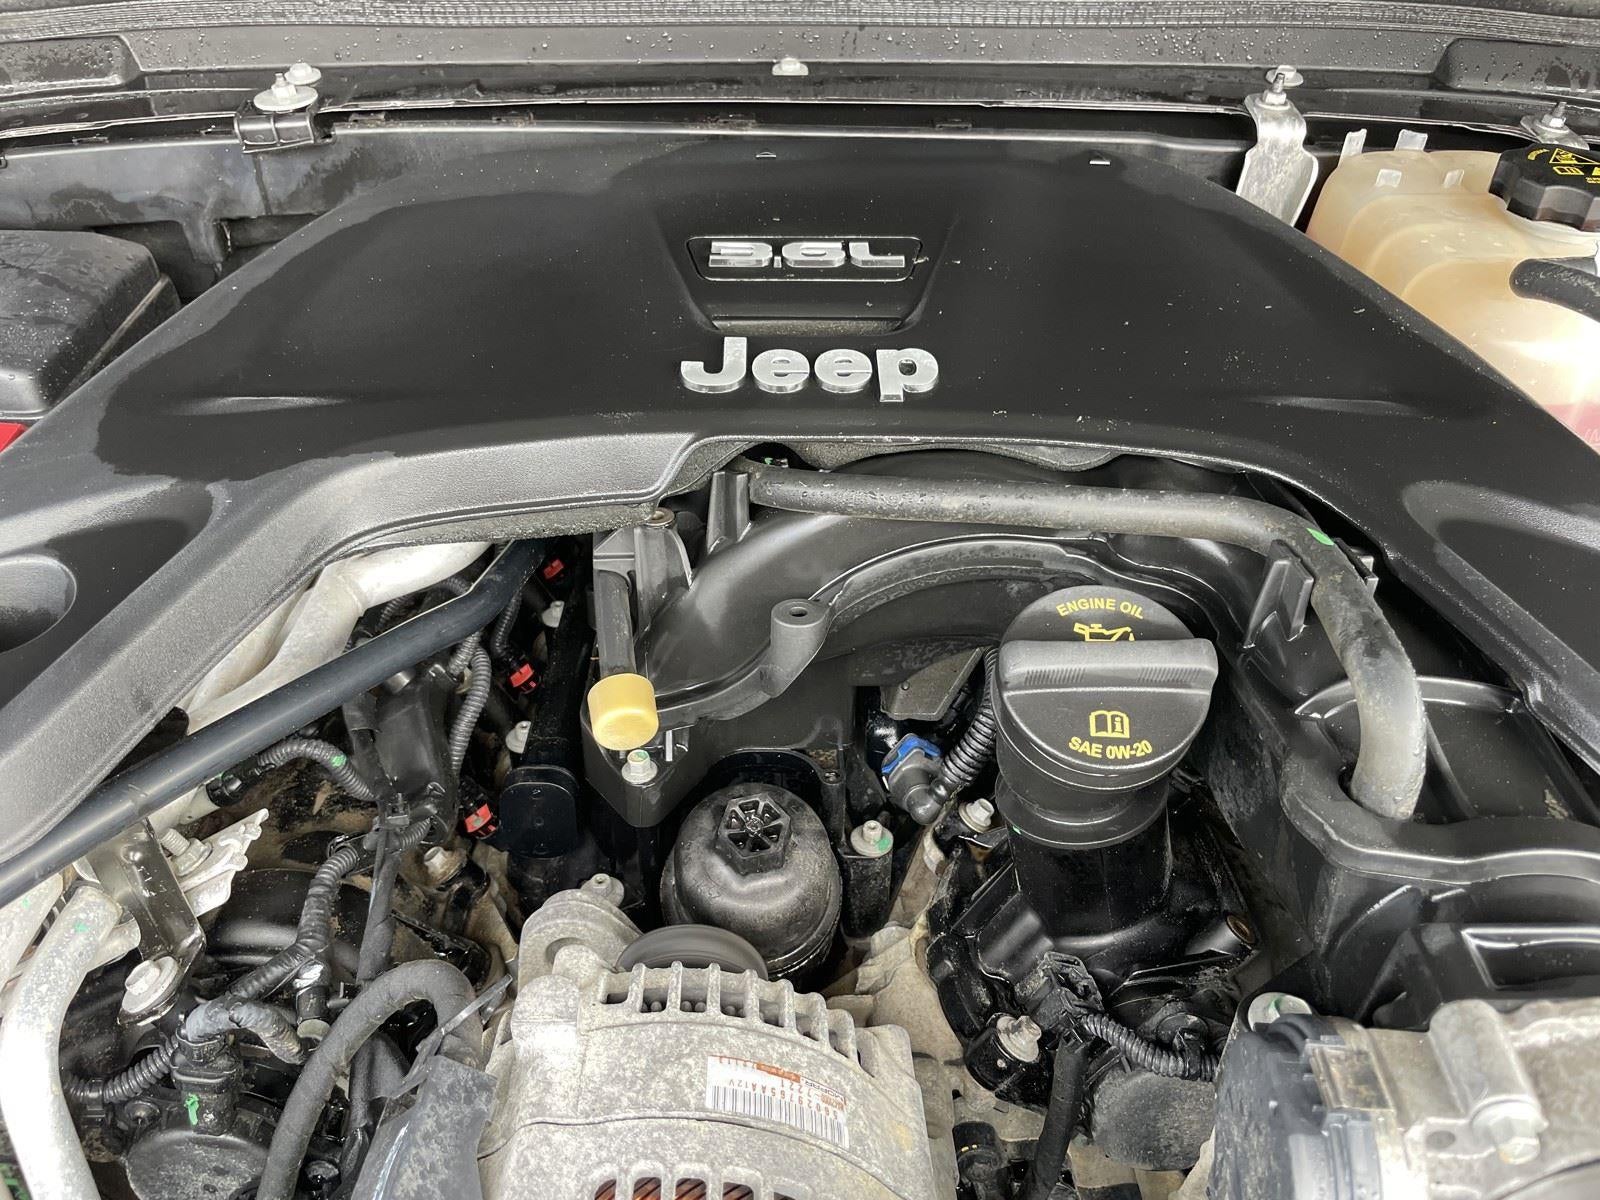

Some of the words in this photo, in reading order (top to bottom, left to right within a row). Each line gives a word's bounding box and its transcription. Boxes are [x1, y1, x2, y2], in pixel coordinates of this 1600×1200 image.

[708, 241, 905, 268] 3.6L
[680, 336, 939, 402] Jeep
[1056, 598, 1116, 617] ENGINE
[1119, 602, 1144, 620] OIL
[1068, 736, 1102, 758] SAE
[1105, 739, 1153, 760] 0W-20
